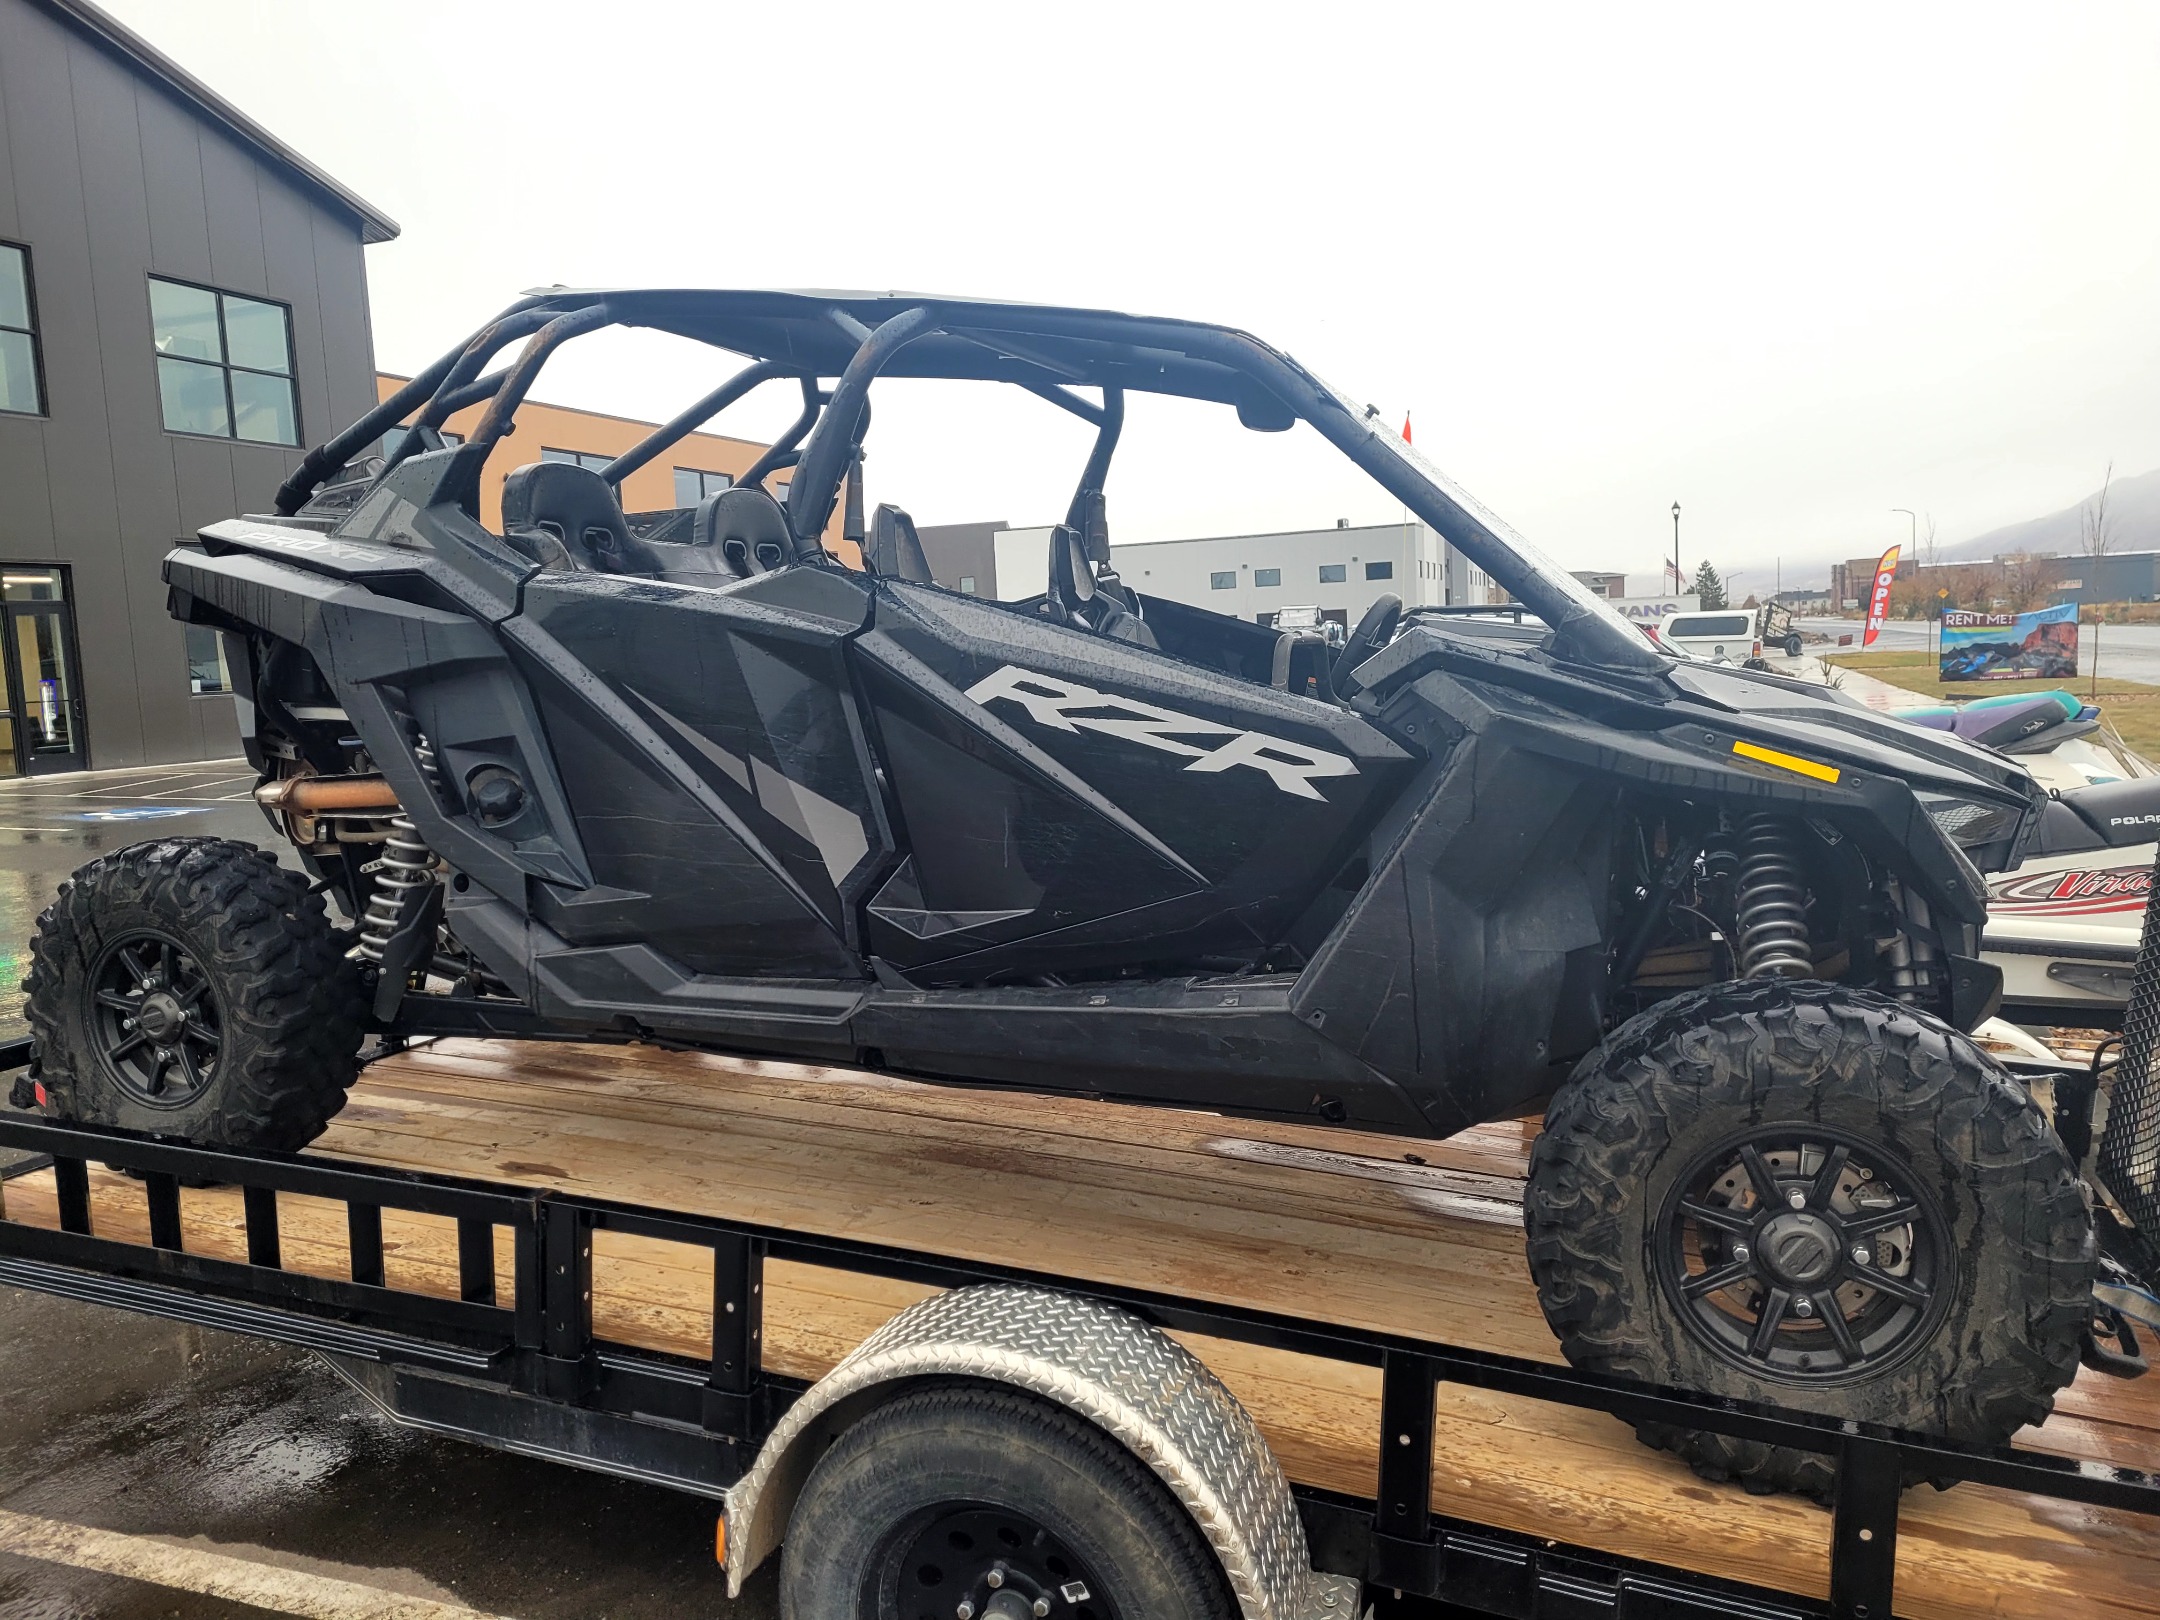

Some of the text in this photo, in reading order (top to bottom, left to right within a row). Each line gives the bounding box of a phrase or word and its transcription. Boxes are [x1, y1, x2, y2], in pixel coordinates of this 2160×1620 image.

[235, 532, 394, 563] PRO XP
[1869, 572, 1893, 631] OPEN
[1945, 614, 2013, 625] RENT ME!
[964, 664, 1361, 802] RZR
